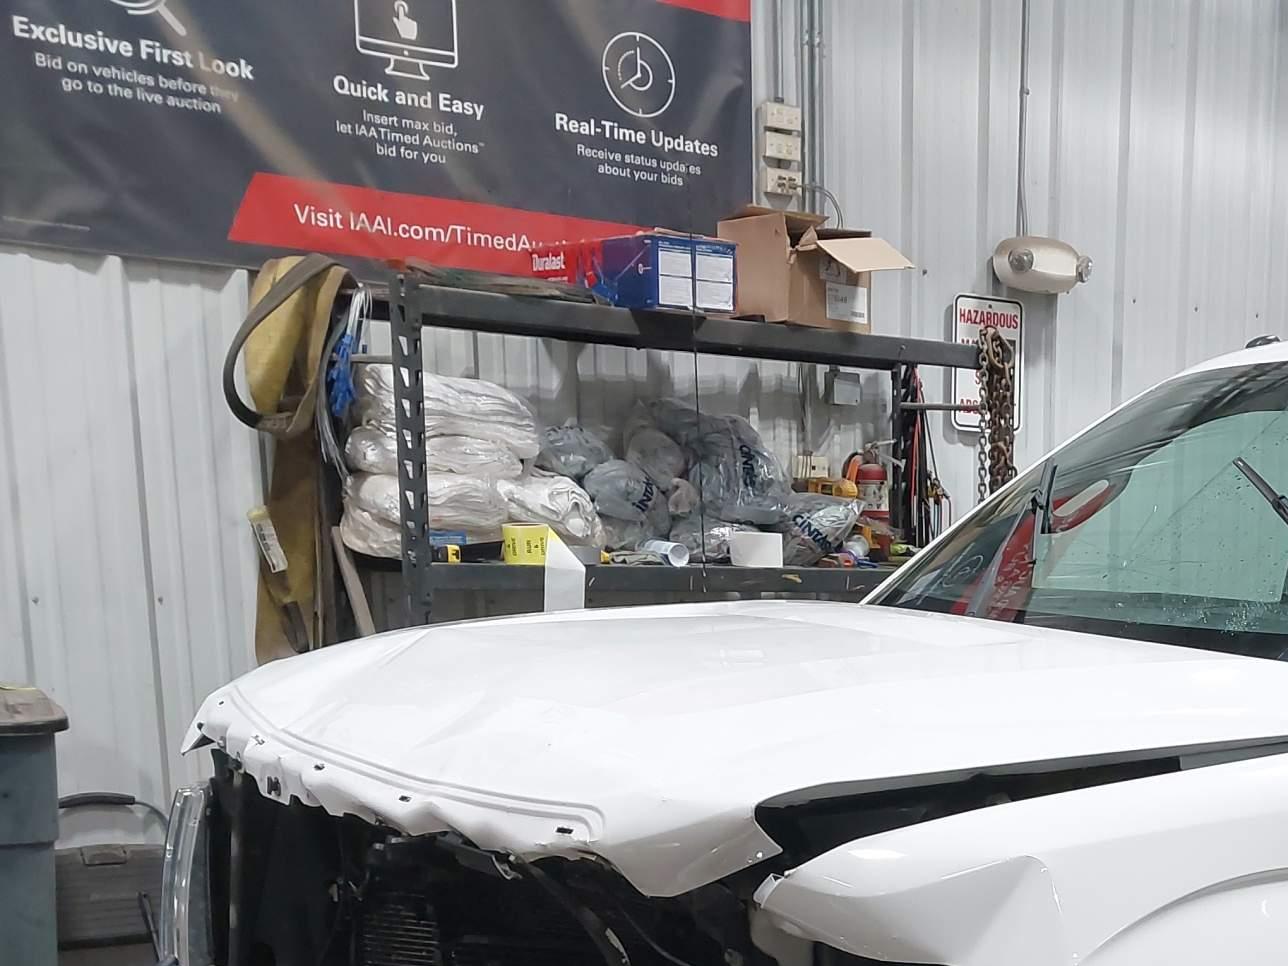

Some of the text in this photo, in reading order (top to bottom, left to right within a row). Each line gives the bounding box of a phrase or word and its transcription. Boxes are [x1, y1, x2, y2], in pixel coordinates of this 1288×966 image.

[12, 15, 254, 80] Exclusive First Look
[35, 52, 63, 71] Bid
[66, 60, 88, 74] on
[92, 66, 155, 87] vehicles
[158, 75, 207, 95] before
[62, 78, 221, 113] go to the live auction
[333, 75, 484, 121] Quick and Easy
[336, 120, 352, 133] let
[363, 110, 458, 136] Insert max bid,
[555, 112, 719, 157] Real-Time Updates
[376, 143, 447, 164] bid for you
[577, 143, 622, 162] Receive
[624, 152, 658, 168] status
[598, 162, 684, 186] about your bids
[293, 203, 344, 229] Visit
[960, 308, 1018, 329] HAZARDOUS
